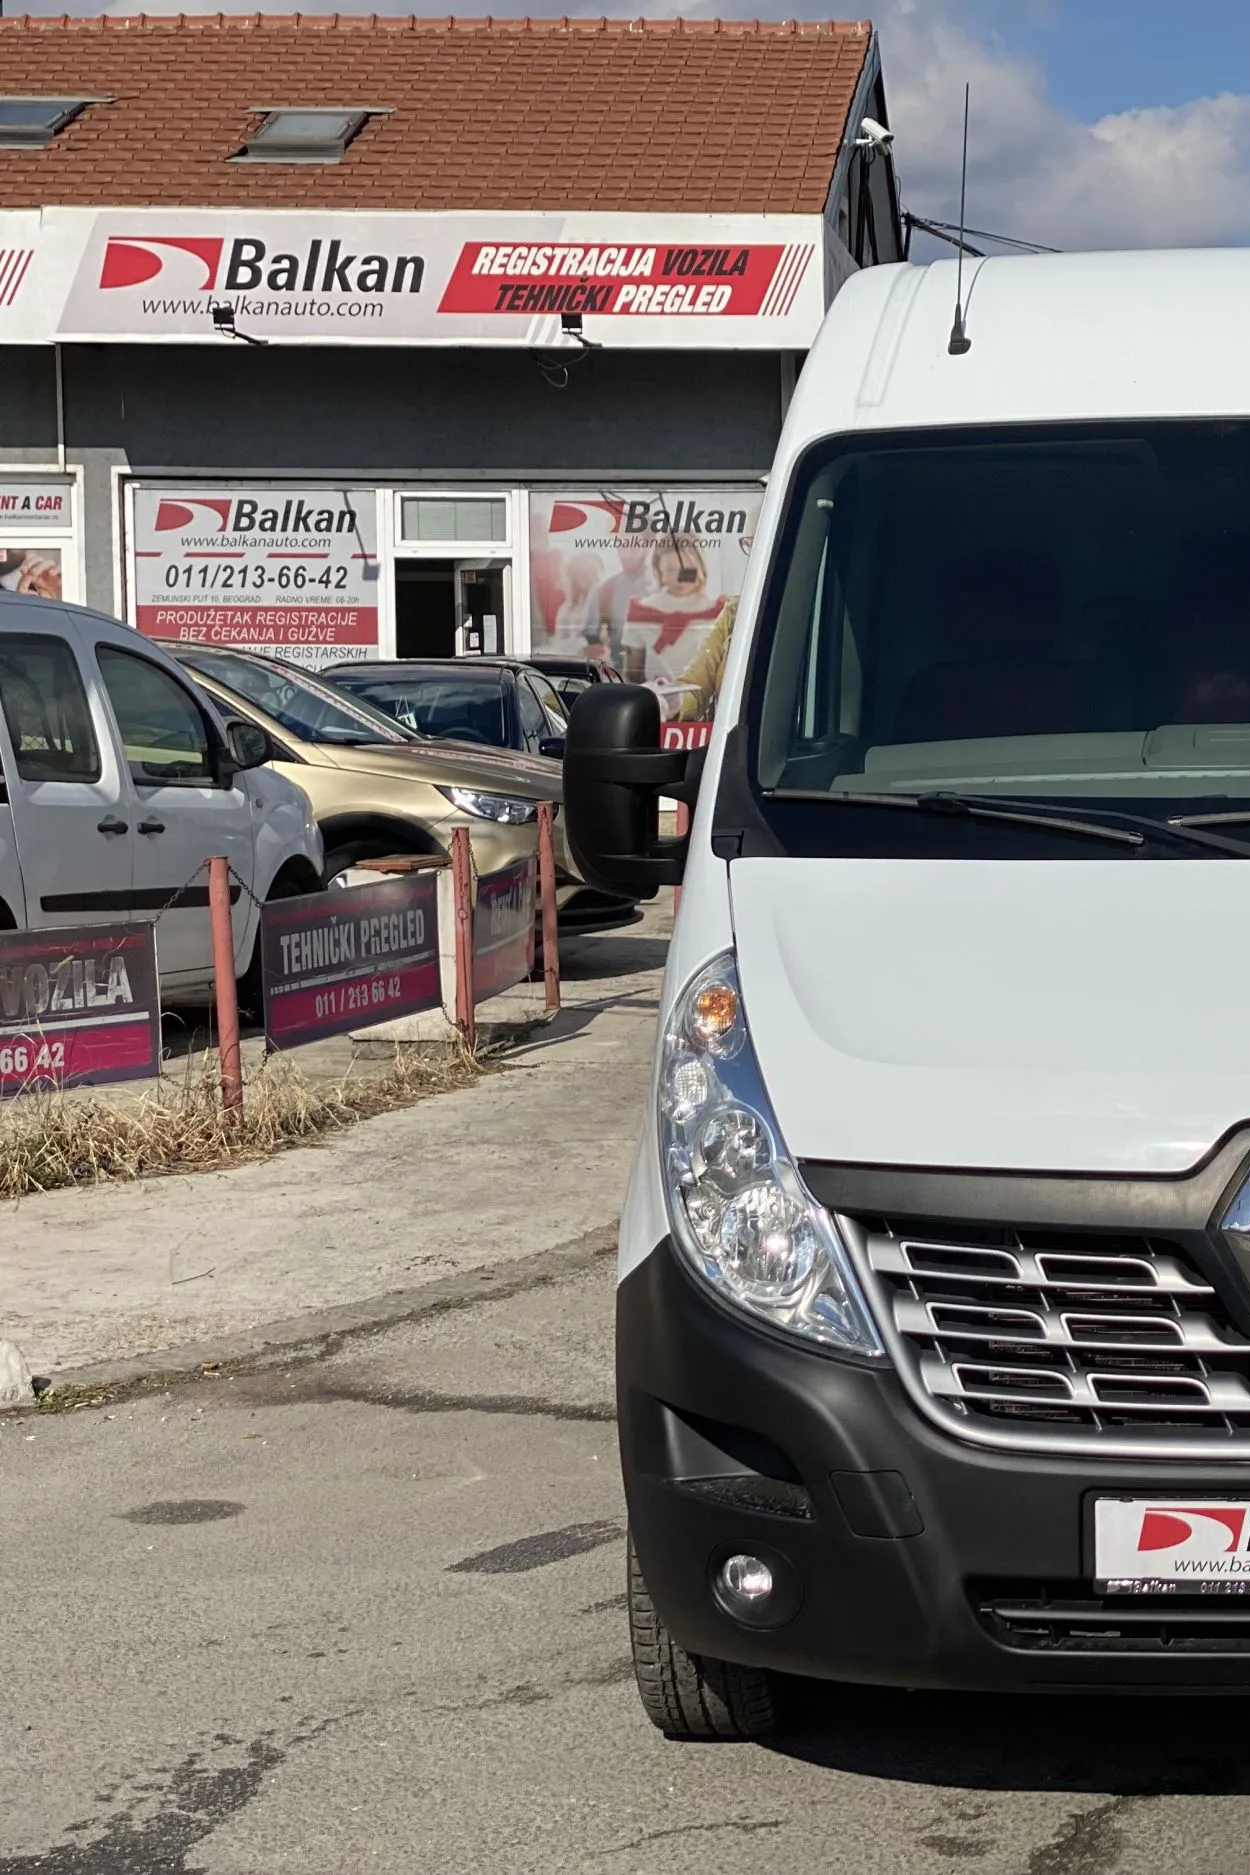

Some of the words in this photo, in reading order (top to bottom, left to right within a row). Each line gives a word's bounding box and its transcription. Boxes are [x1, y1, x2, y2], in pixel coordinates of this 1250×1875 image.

[225, 238, 425, 292] Balkan
[471, 246, 656, 277] REGISTRACIJA
[661, 248, 751, 277] VOZILA
[493, 276, 614, 312] TEHNIČKI
[611, 284, 733, 313] PREGLED
[21, 496, 31, 510] A
[35, 496, 63, 511] CAR
[232, 499, 357, 533] Balkan
[624, 500, 747, 534] Balkan
[181, 534, 331, 548] www.balkanauto.com
[574, 536, 722, 550] www.balkanauto.com
[165, 564, 349, 590] 011/213-66-42
[151, 594, 191, 603] ZEMUNSKI
[192, 594, 209, 603] PUT
[222, 594, 261, 604] BEOGRAD
[275, 595, 304, 604] RADNO
[156, 609, 252, 626] PRODUŽETAK
[256, 611, 358, 626] REGISTRACIJE
[179, 627, 206, 641] BEZ
[211, 624, 275, 641] ČEKANJA
[287, 625, 336, 642] GUŽVE
[274, 647, 368, 660] REGISTARSKIH
[279, 915, 356, 976] TEHNIČKI
[360, 908, 425, 958] PREGLED
[315, 992, 336, 1018] 011
[348, 985, 369, 1010] 213
[371, 981, 385, 1004] 66
[388, 977, 401, 999] 42
[0, 1046, 28, 1074] 66
[37, 1042, 65, 1069] 42
[1132, 1579, 1177, 1594] Balkan
[1200, 1581, 1221, 1594] 011
[1225, 1581, 1246, 1594] 213
